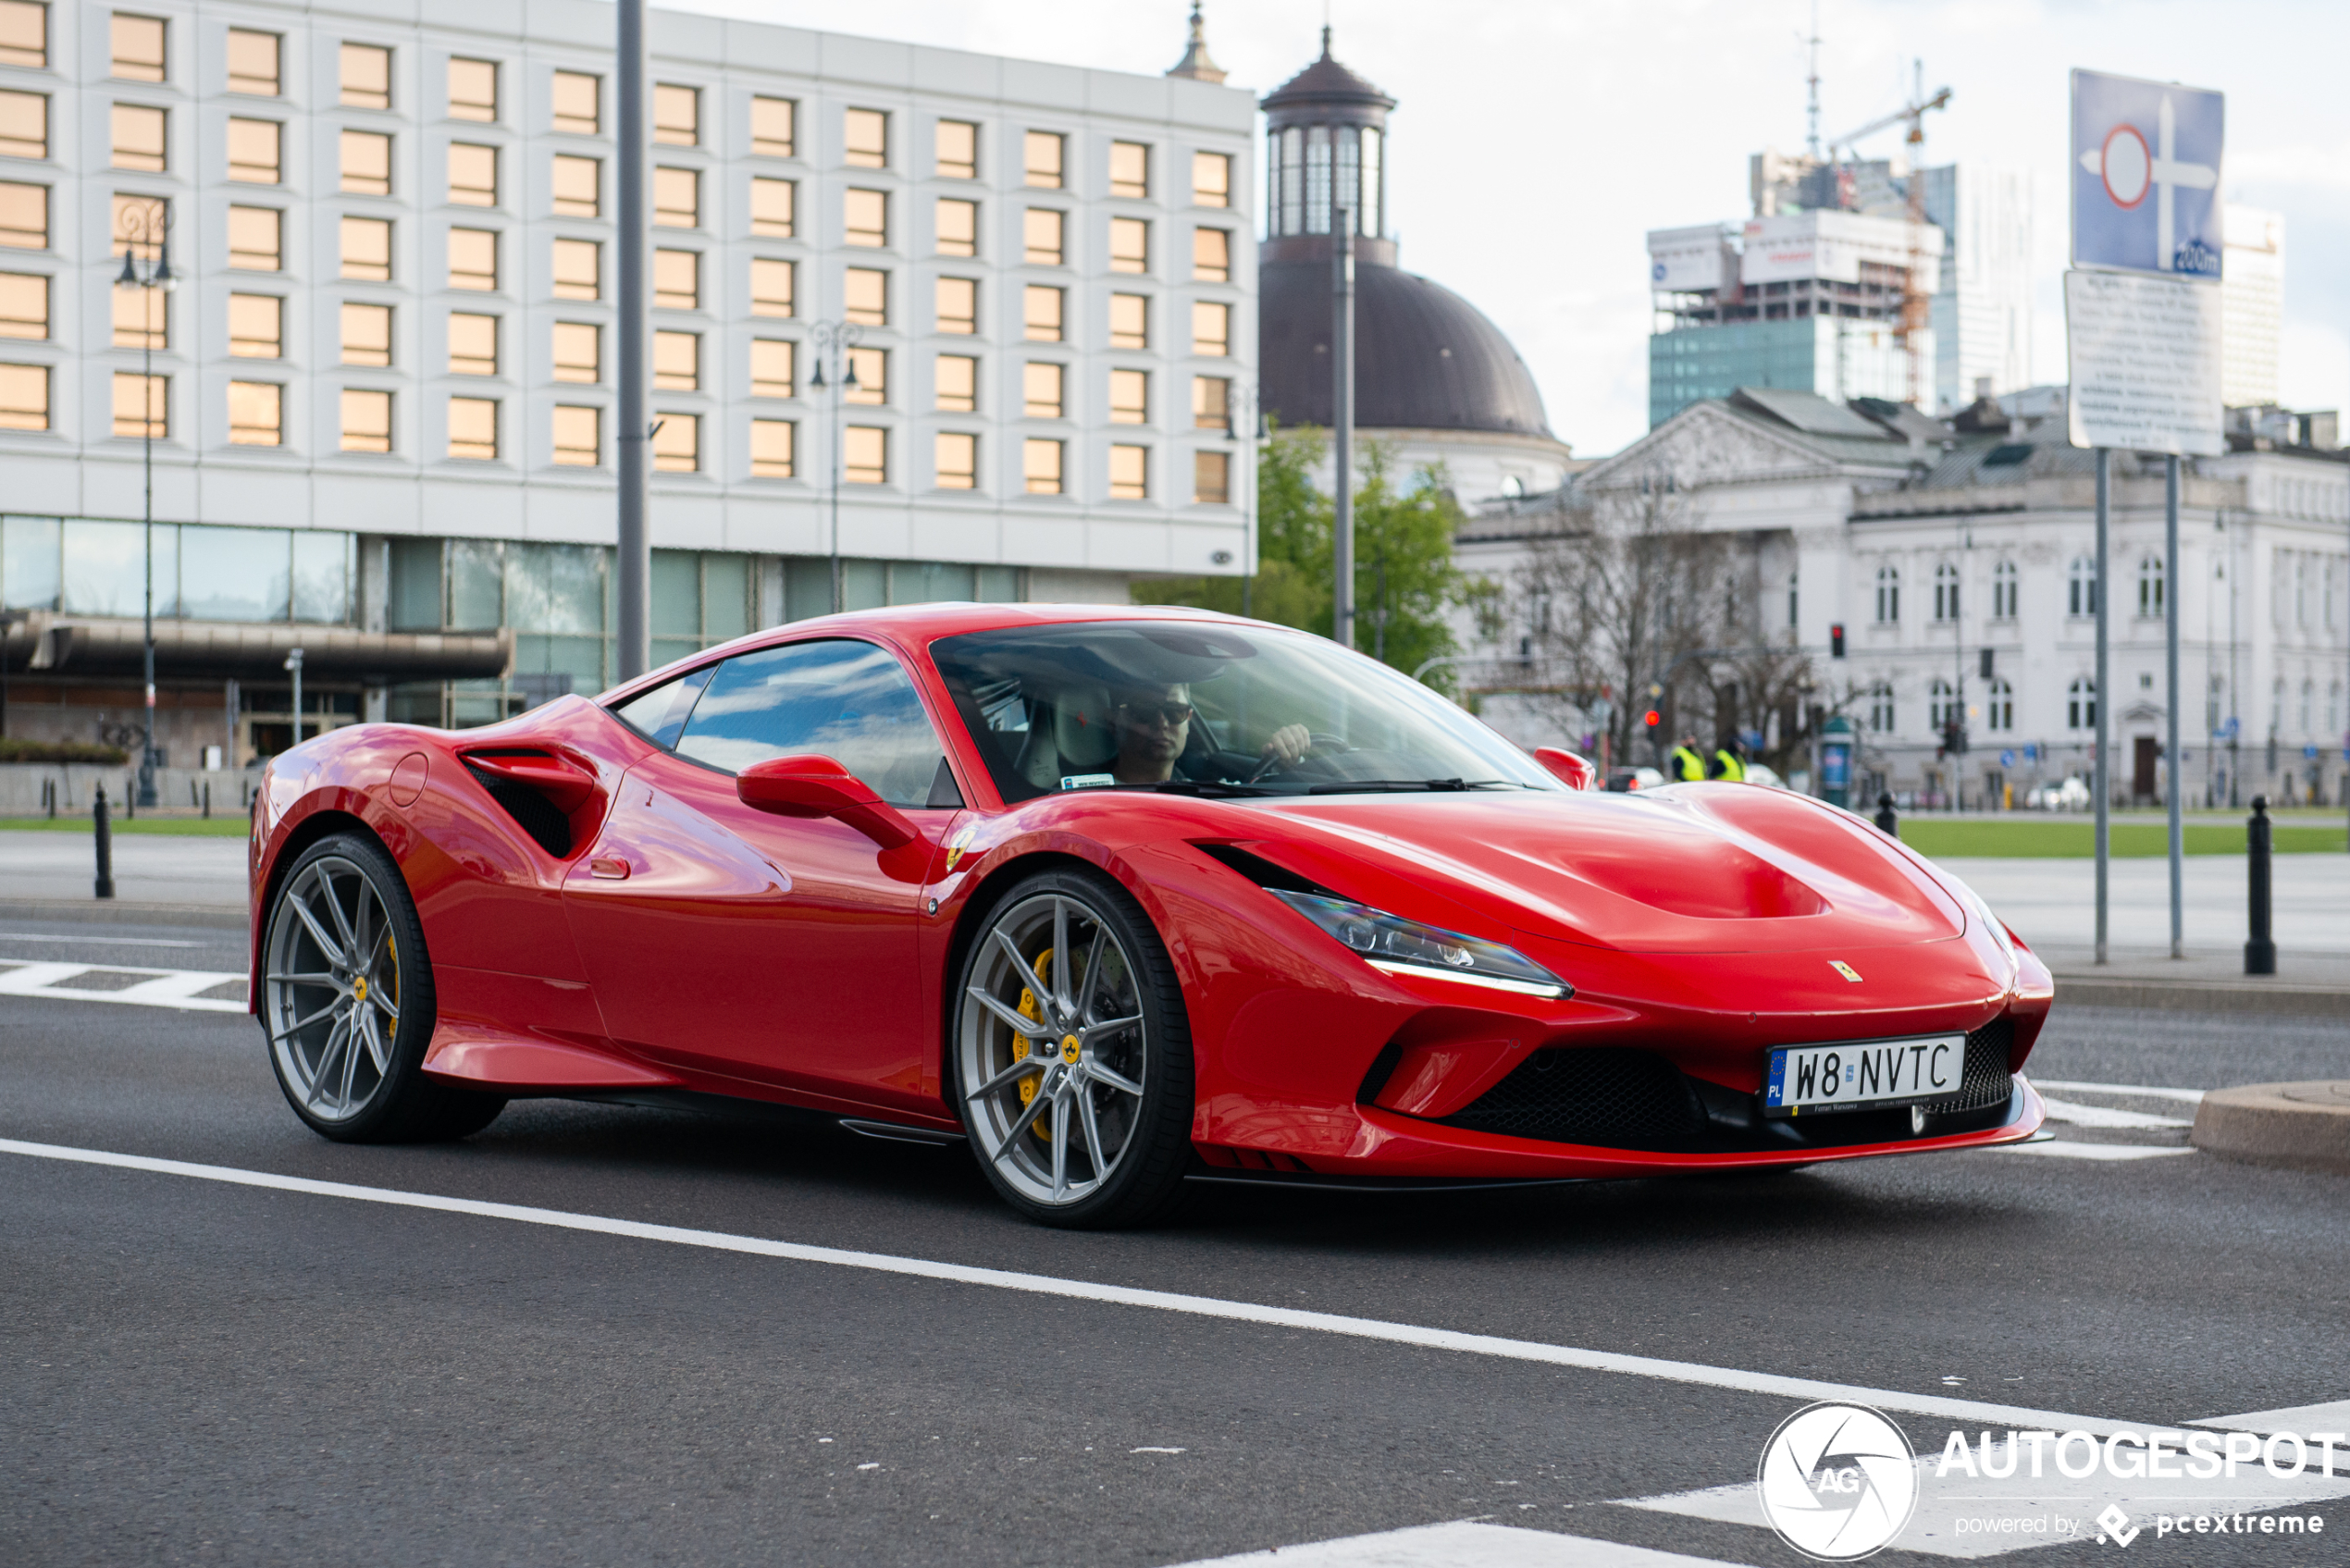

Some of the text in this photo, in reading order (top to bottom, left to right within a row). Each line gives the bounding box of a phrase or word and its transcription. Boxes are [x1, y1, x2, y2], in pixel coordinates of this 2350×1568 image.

[2177, 244, 2218, 272] 200m
[1796, 1043, 1949, 1100] W8 NVTC
[1768, 1084, 1781, 1098] PL
[1814, 1103, 1858, 1113] Ferrari Warszawa
